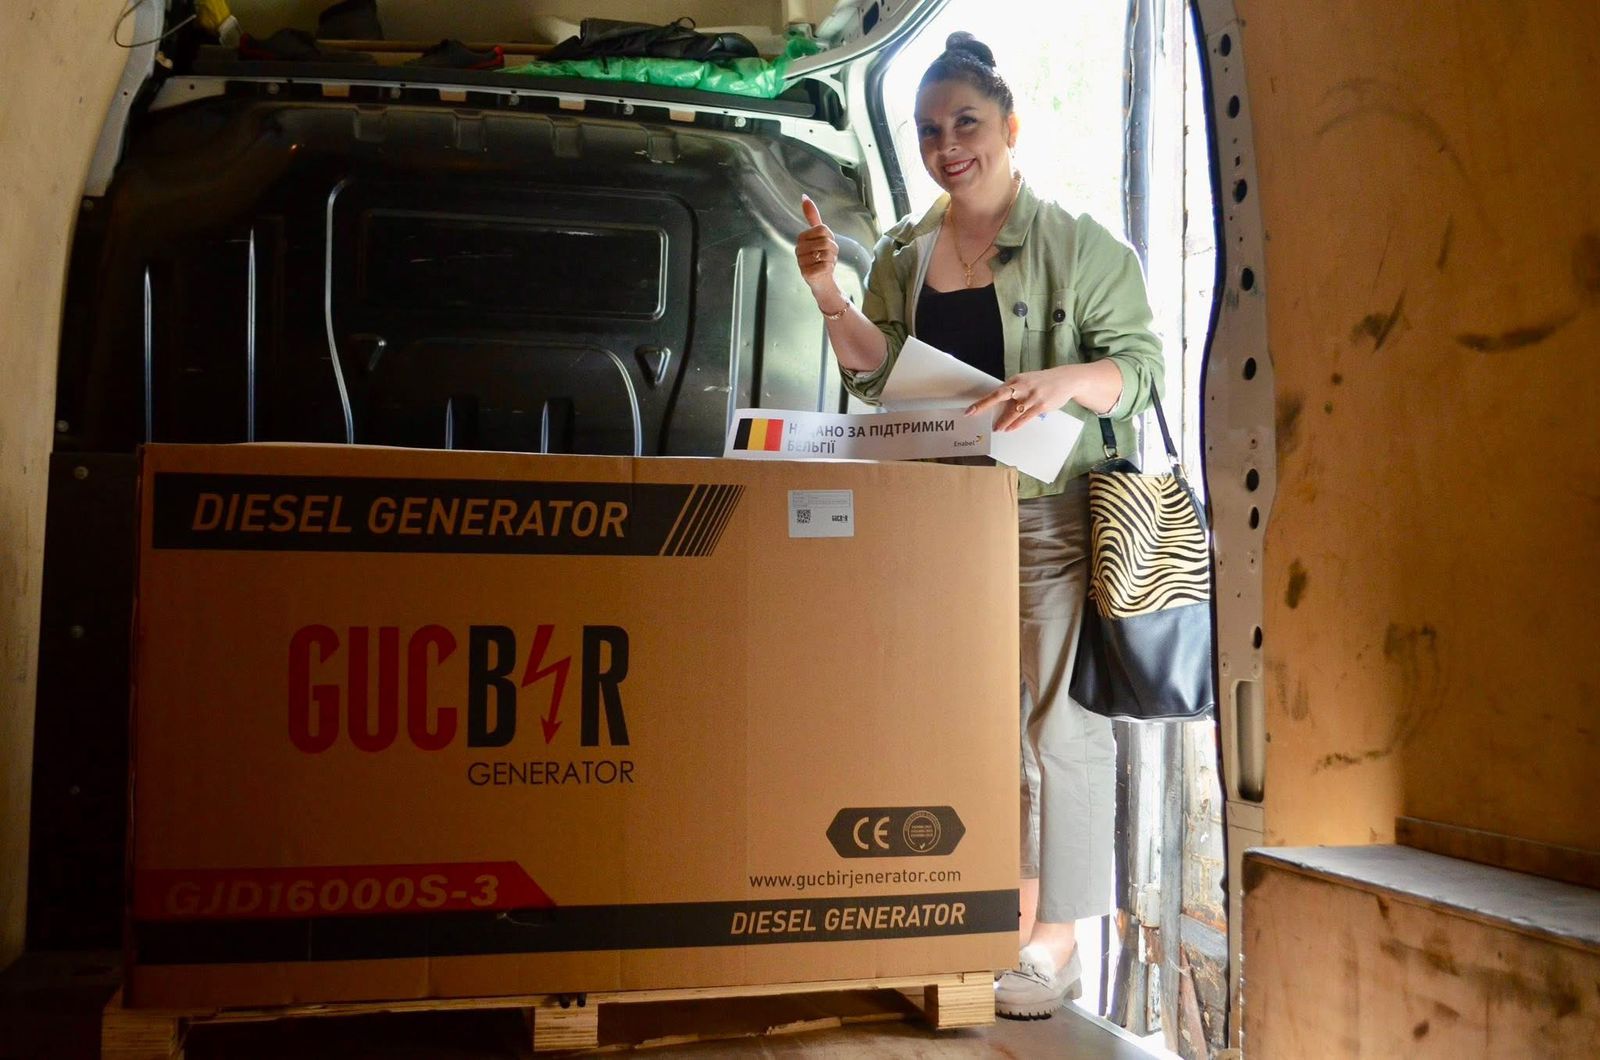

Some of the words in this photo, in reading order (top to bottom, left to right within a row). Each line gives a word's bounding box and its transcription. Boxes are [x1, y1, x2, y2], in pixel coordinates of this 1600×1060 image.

[788, 422, 845, 437] НАНО
[848, 426, 866, 438] ЗА
[870, 420, 955, 438] ПІДТРИМКИ
[953, 440, 976, 448] Enabel
[191, 493, 353, 535] DIESEL
[367, 496, 629, 539] GENERATOR
[467, 759, 635, 787] GENERATOR
[852, 816, 890, 850] CE
[164, 873, 500, 915] GJD16000S-3
[749, 869, 962, 890] www.gucbirjenerator.com
[730, 909, 817, 935] DIESEL
[824, 902, 967, 931] GENERATOR
